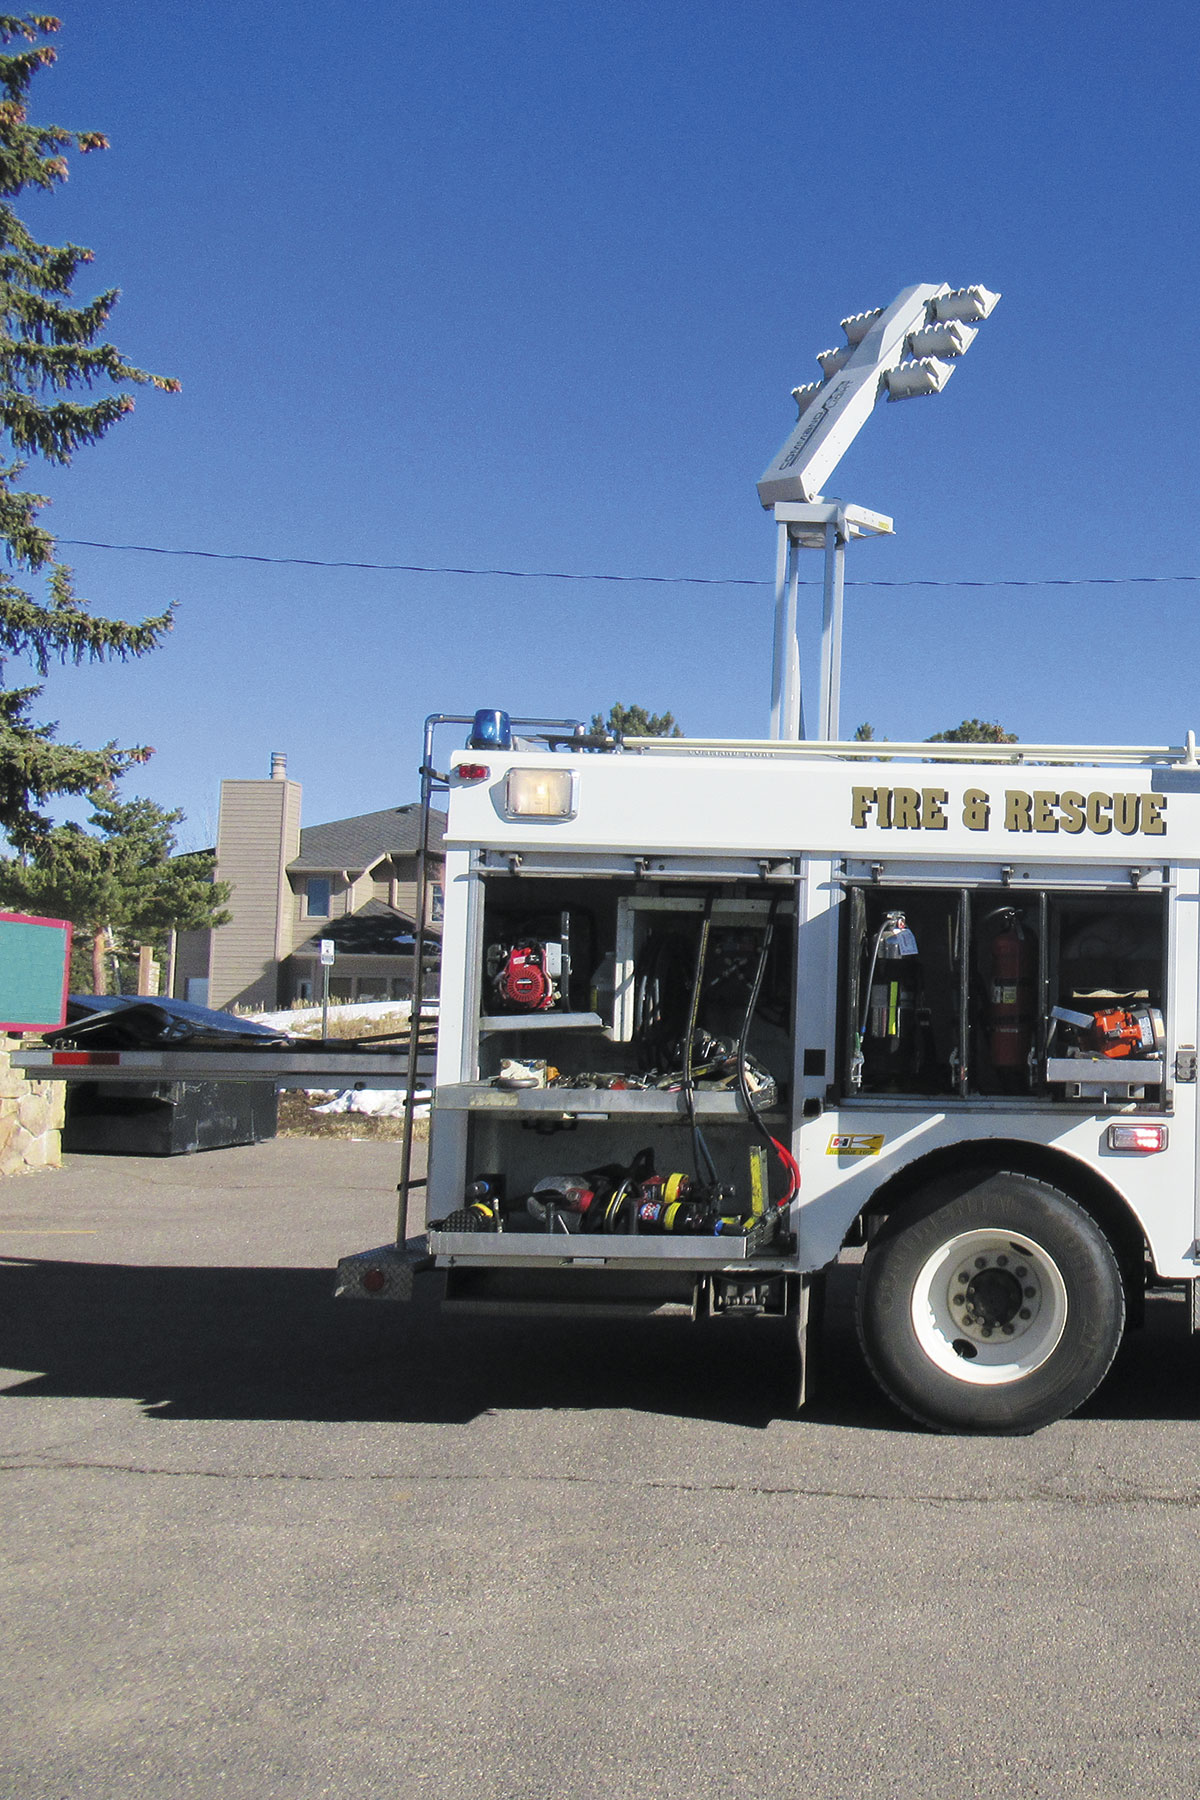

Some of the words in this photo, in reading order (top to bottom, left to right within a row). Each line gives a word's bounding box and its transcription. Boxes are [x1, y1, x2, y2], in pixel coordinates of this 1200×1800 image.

[851, 786, 948, 830] FIRE
[962, 788, 991, 832] &
[1004, 790, 1168, 836] RESCUE
